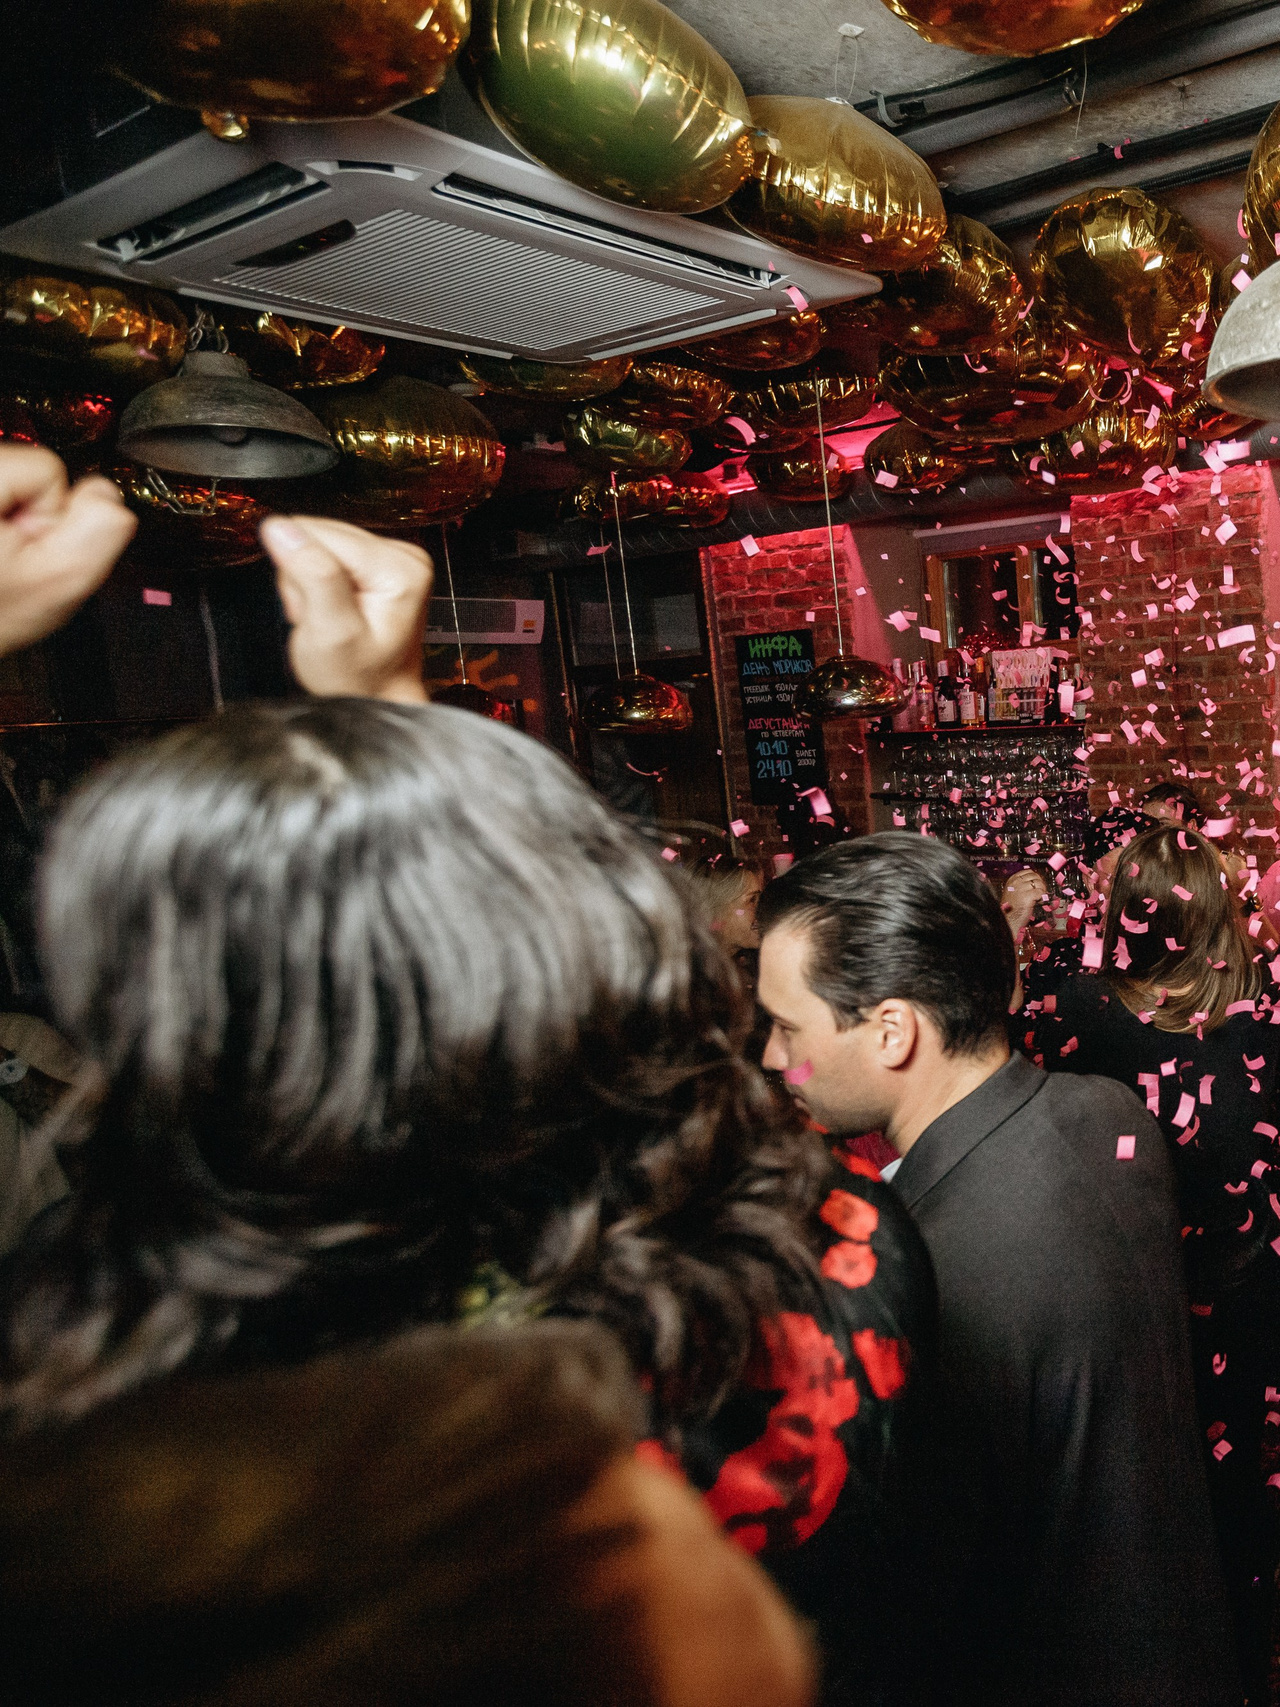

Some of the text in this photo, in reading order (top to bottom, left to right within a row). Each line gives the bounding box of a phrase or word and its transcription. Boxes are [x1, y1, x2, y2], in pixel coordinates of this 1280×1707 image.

[748, 634, 803, 658] ИНФА
[742, 661, 771, 676] ДЕНЬ
[795, 748, 817, 758] БИЛЕТ
